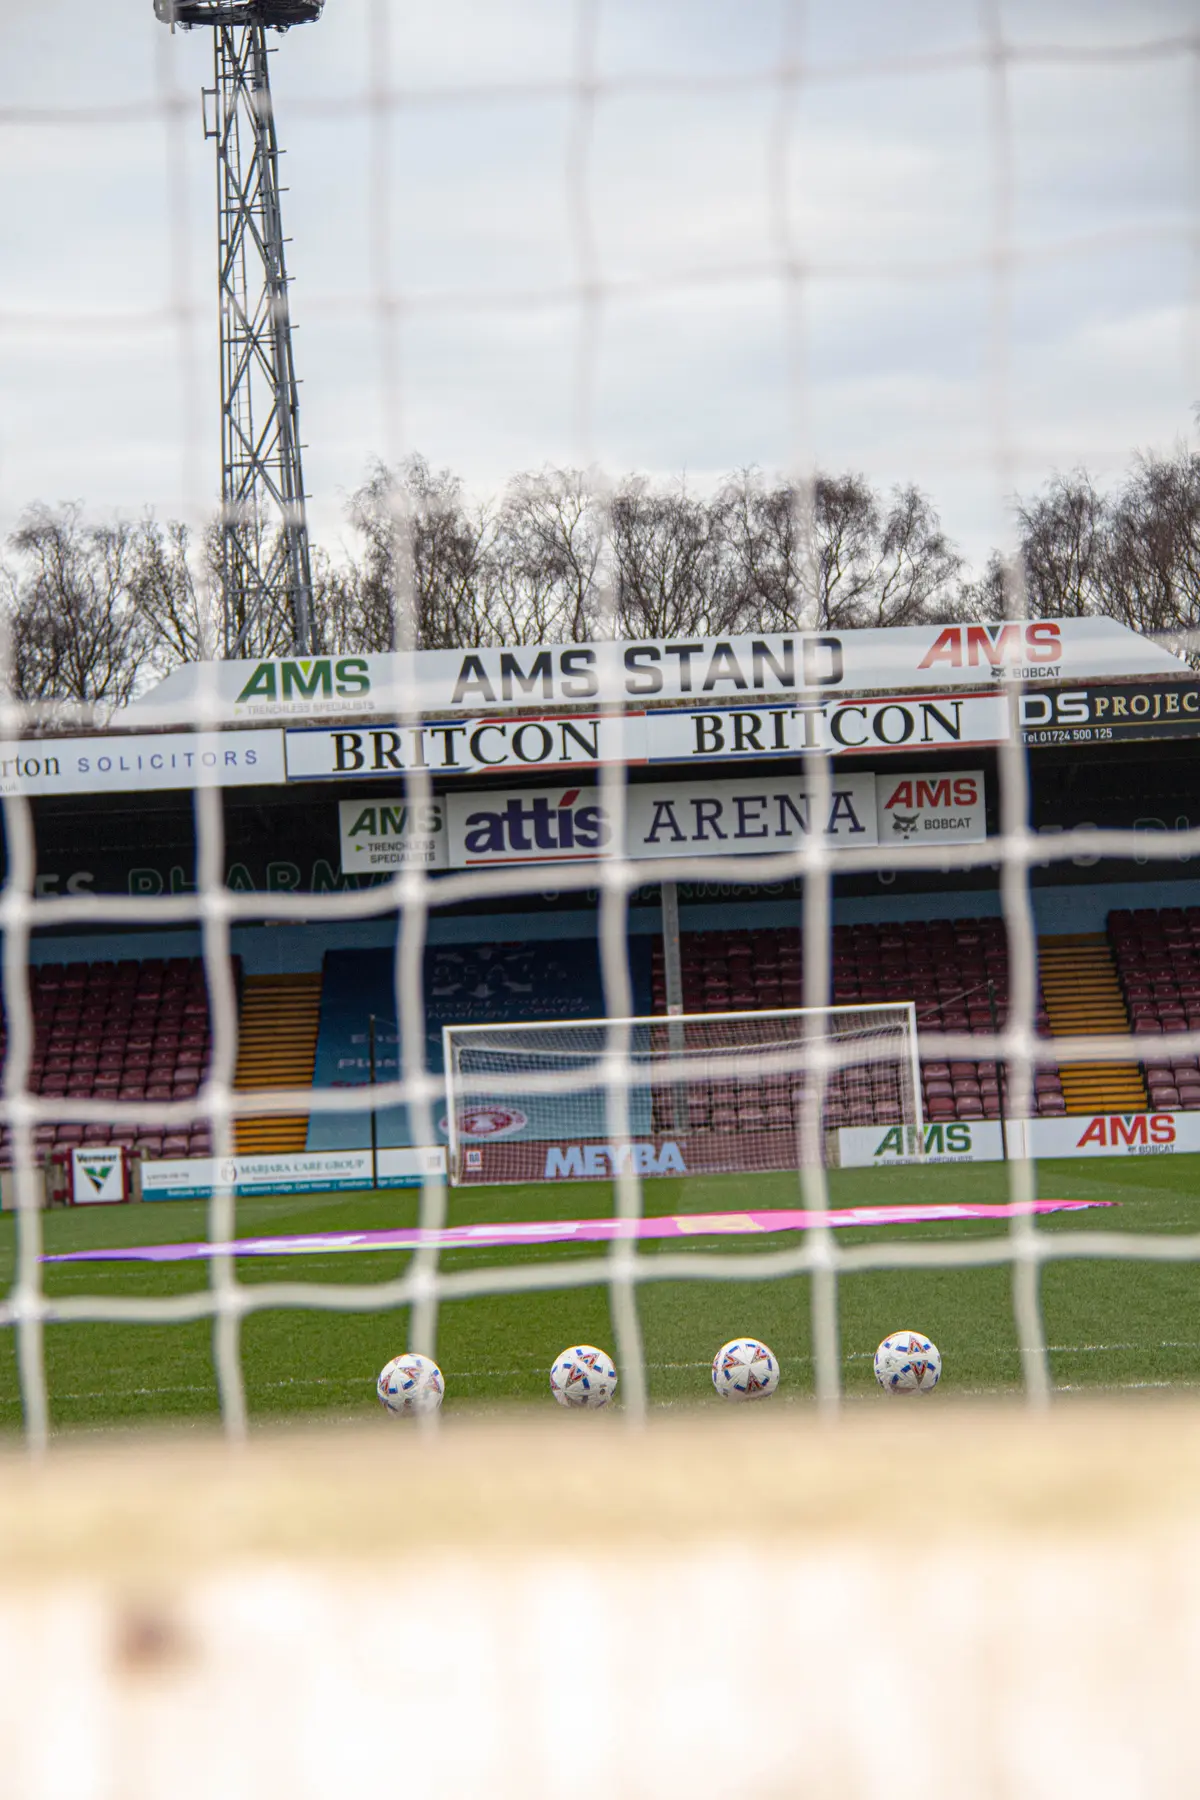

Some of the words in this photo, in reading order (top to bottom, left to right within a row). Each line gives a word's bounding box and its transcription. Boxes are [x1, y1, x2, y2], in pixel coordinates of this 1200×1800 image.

[917, 622, 1063, 669] AMS
[235, 658, 371, 703] AMS
[451, 649, 600, 703] AMS
[624, 637, 844, 694] STAND
[1013, 666, 1061, 679] BOBCAT
[313, 700, 376, 713] SPECIALISTS
[1018, 691, 1089, 725] DS
[1095, 691, 1200, 718] PROJEC
[690, 701, 964, 753] BRITCON
[1040, 730, 1070, 743] 01724
[1073, 729, 1091, 741] 500
[1094, 728, 1112, 740] 125
[77, 749, 258, 773] SOLICITORS
[330, 721, 601, 772] BRITCON
[884, 778, 978, 810] AMS
[348, 805, 443, 837] AMS
[643, 791, 866, 844] ARENA
[924, 817, 972, 831] BOBCAT
[874, 1121, 973, 1157] AMS
[1076, 1113, 1176, 1148] AMS
[76, 1153, 117, 1163] Vermeer
[293, 1161, 321, 1172] CARE
[324, 1159, 364, 1171] GROUP
[544, 1141, 687, 1178] MEYBA
